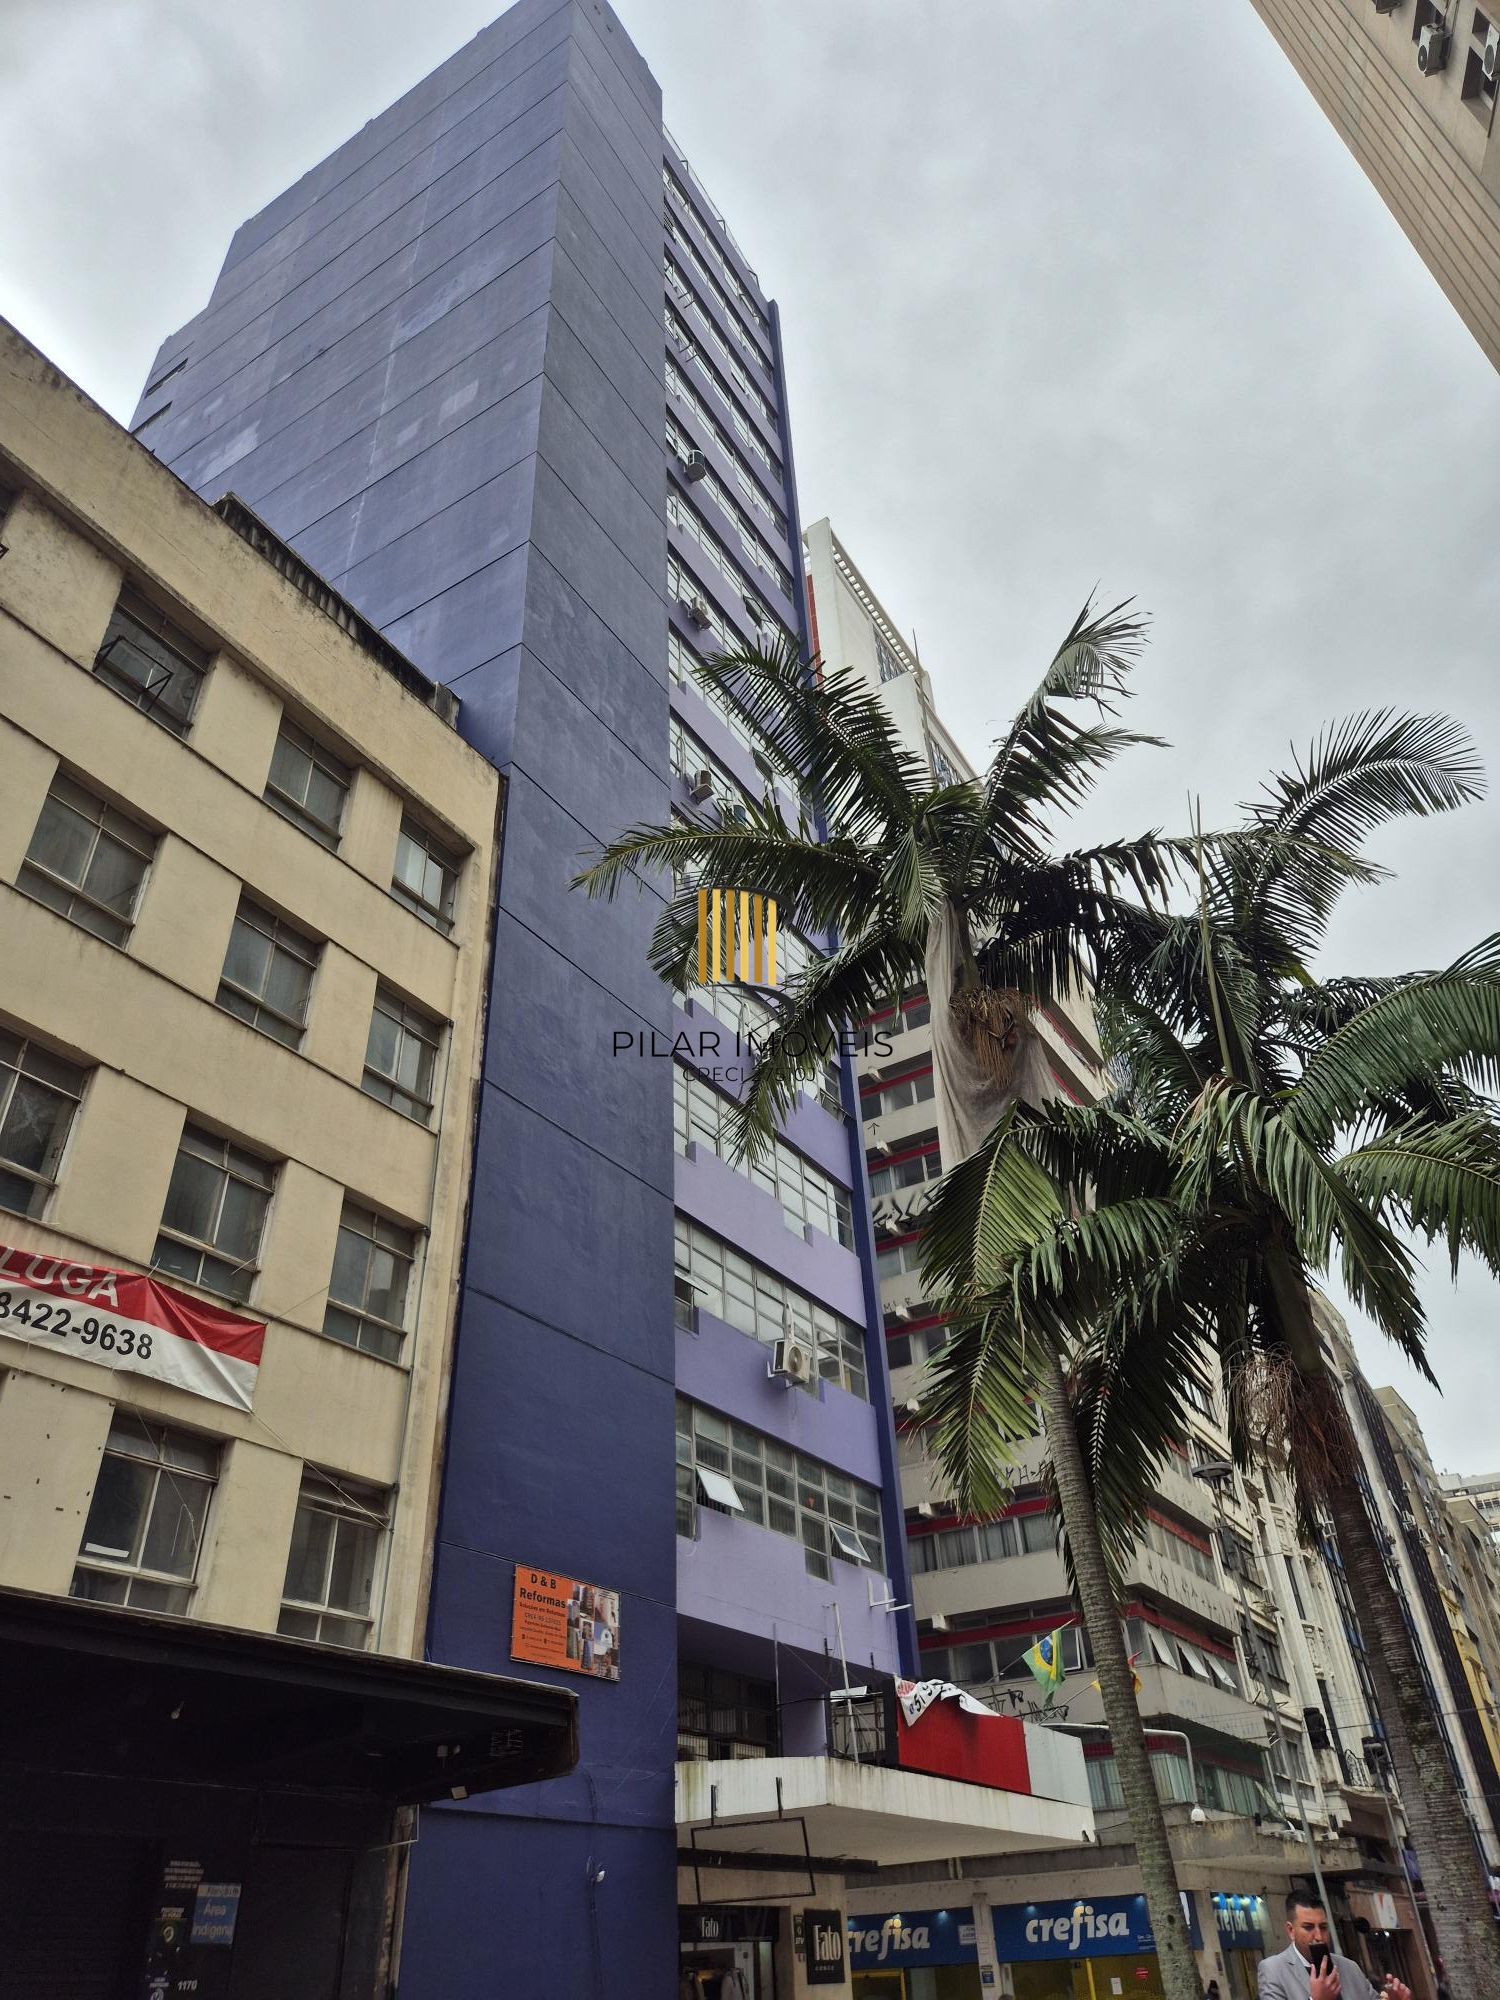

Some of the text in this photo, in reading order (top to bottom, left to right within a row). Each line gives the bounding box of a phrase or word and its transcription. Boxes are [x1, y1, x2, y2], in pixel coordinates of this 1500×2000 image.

[0, 1246, 119, 1308] LUGA
[0, 1291, 153, 1360] 8422-9638
[519, 1587, 566, 1609] Reformas
[531, 1573, 538, 1584] D
[550, 1578, 557, 1590] B
[812, 1924, 841, 1961] Fato
[1025, 1905, 1130, 1951] crefisa
[177, 1980, 198, 1991] 1170
